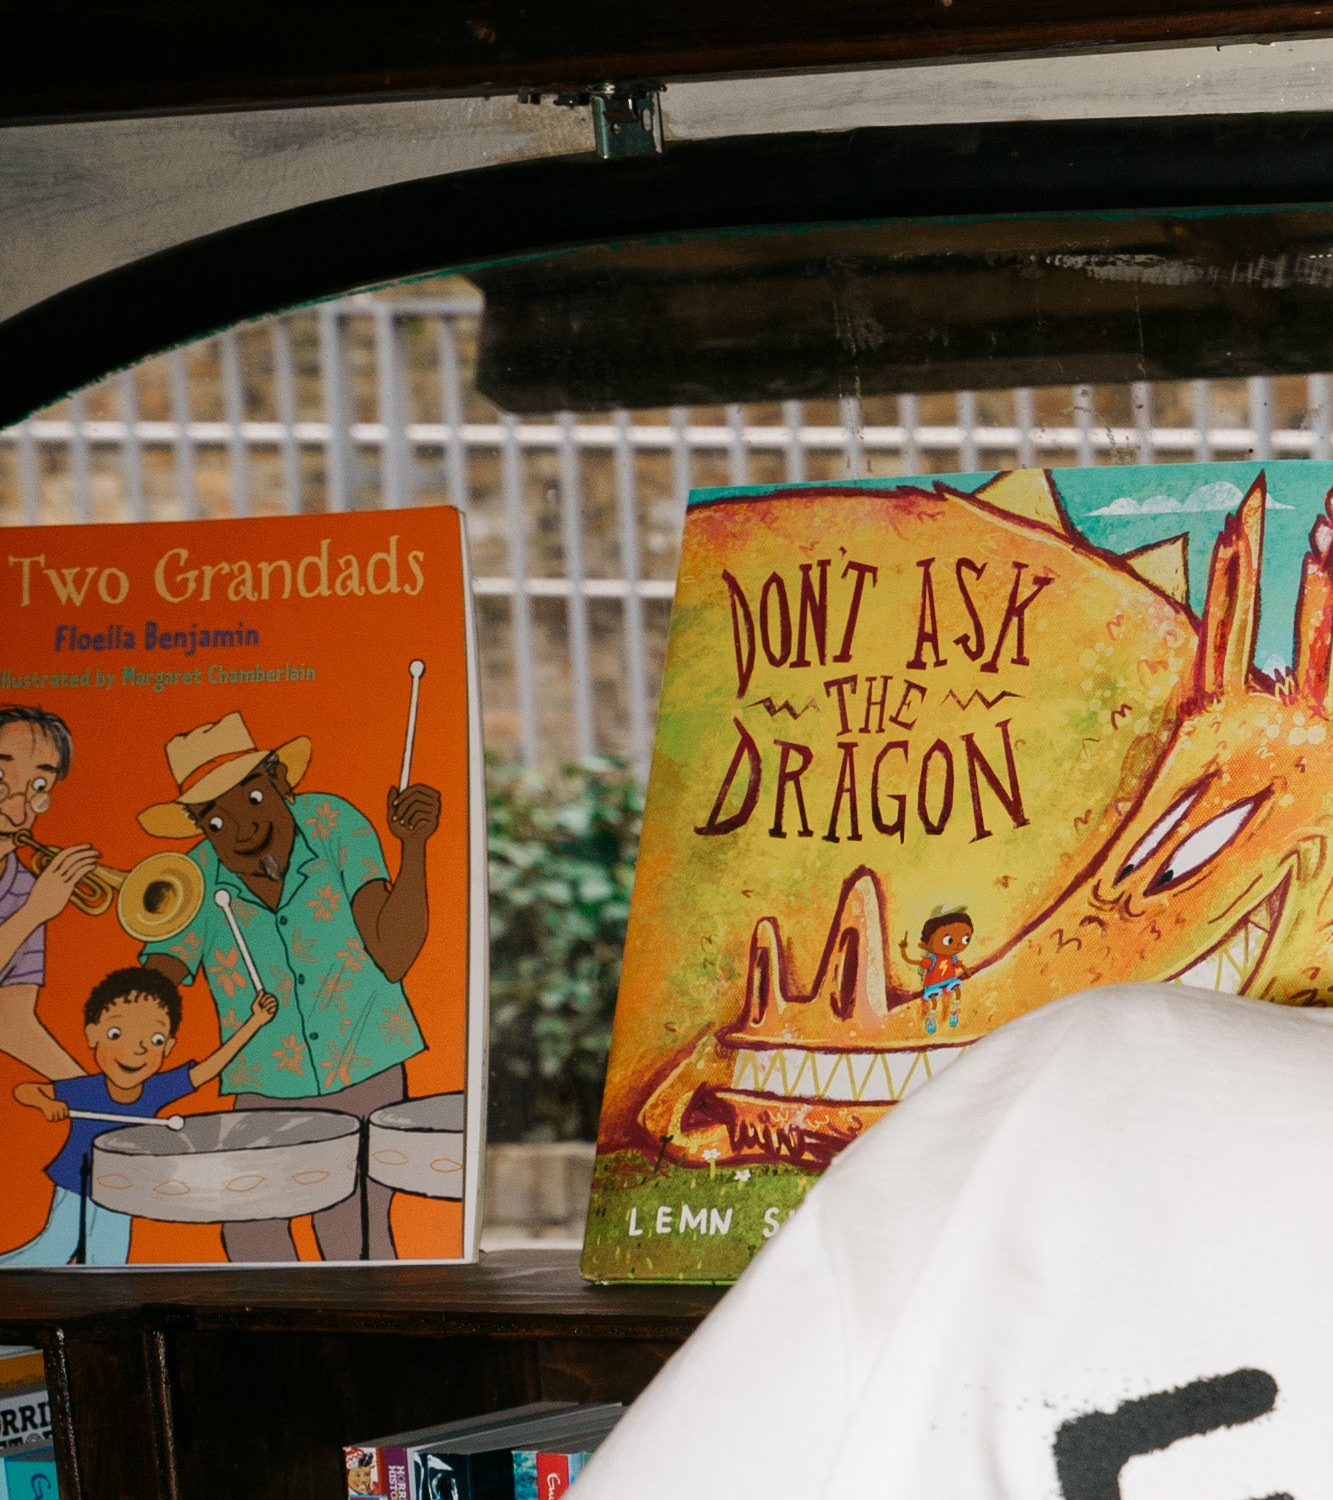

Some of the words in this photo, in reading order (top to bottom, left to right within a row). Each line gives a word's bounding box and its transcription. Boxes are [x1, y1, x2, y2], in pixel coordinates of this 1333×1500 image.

[8, 554, 130, 608] Two
[154, 535, 425, 604] Grandads
[54, 625, 135, 652] Floella
[144, 620, 259, 657] Benjamin
[721, 547, 879, 699] DON'T
[905, 557, 1054, 674] ASK
[95, 671, 116, 691] by
[122, 666, 201, 693] Margaret
[207, 663, 317, 685] Chamberlain
[822, 675, 926, 736] THE
[692, 718, 1035, 848] DRAGON
[628, 1203, 733, 1236] LEMN
